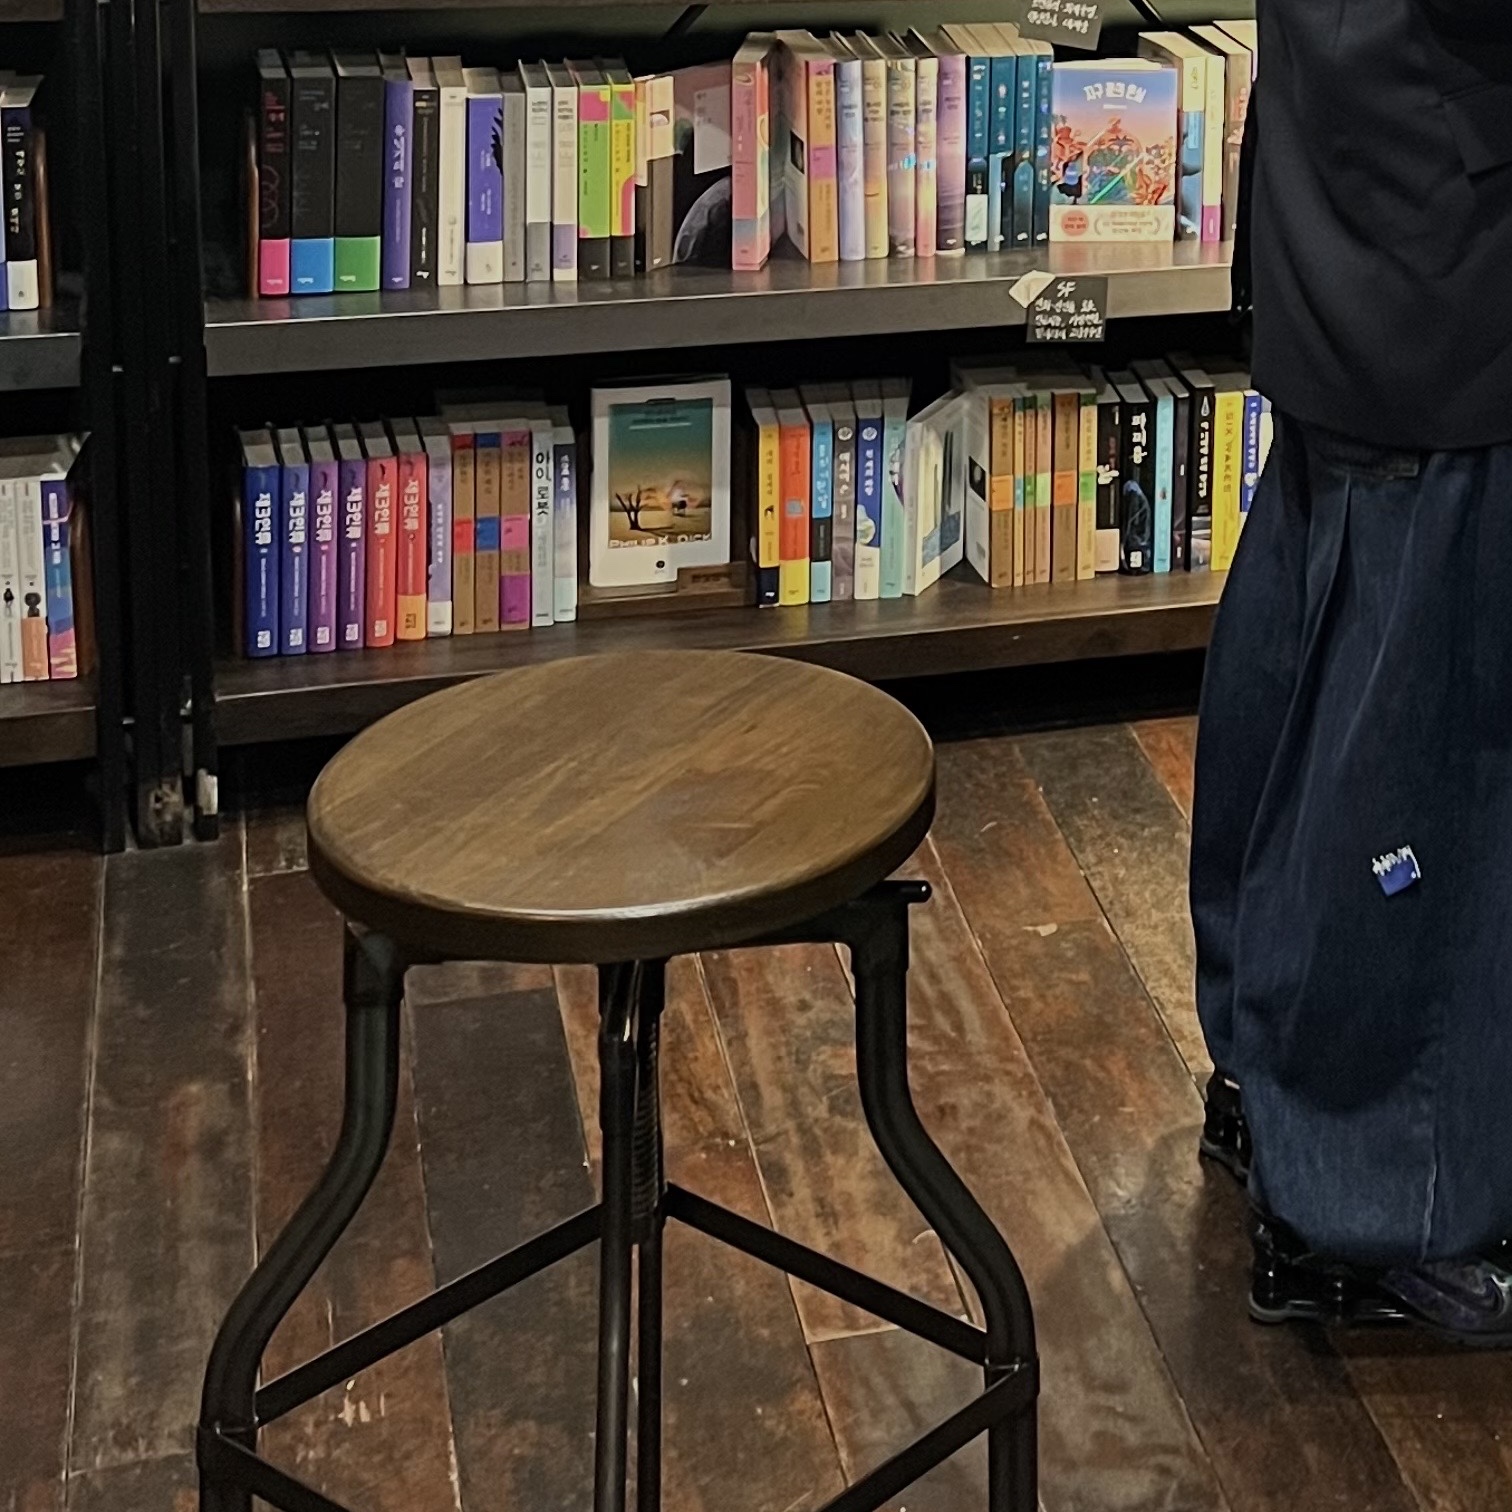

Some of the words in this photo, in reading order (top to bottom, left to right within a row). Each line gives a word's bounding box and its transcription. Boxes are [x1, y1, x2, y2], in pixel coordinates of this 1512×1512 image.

[1057, 281, 1076, 297] SF
[1225, 411, 1233, 436] SIX
[1224, 440, 1233, 493] WAKES
[255, 492, 272, 545] 제3인류
[289, 491, 306, 544] 제3인류
[316, 489, 333, 542] 제3인류
[346, 486, 362, 539] 제3인류
[374, 483, 390, 535] 제3인류
[404, 480, 420, 531] 제3인류
[676, 532, 712, 543] DICK
